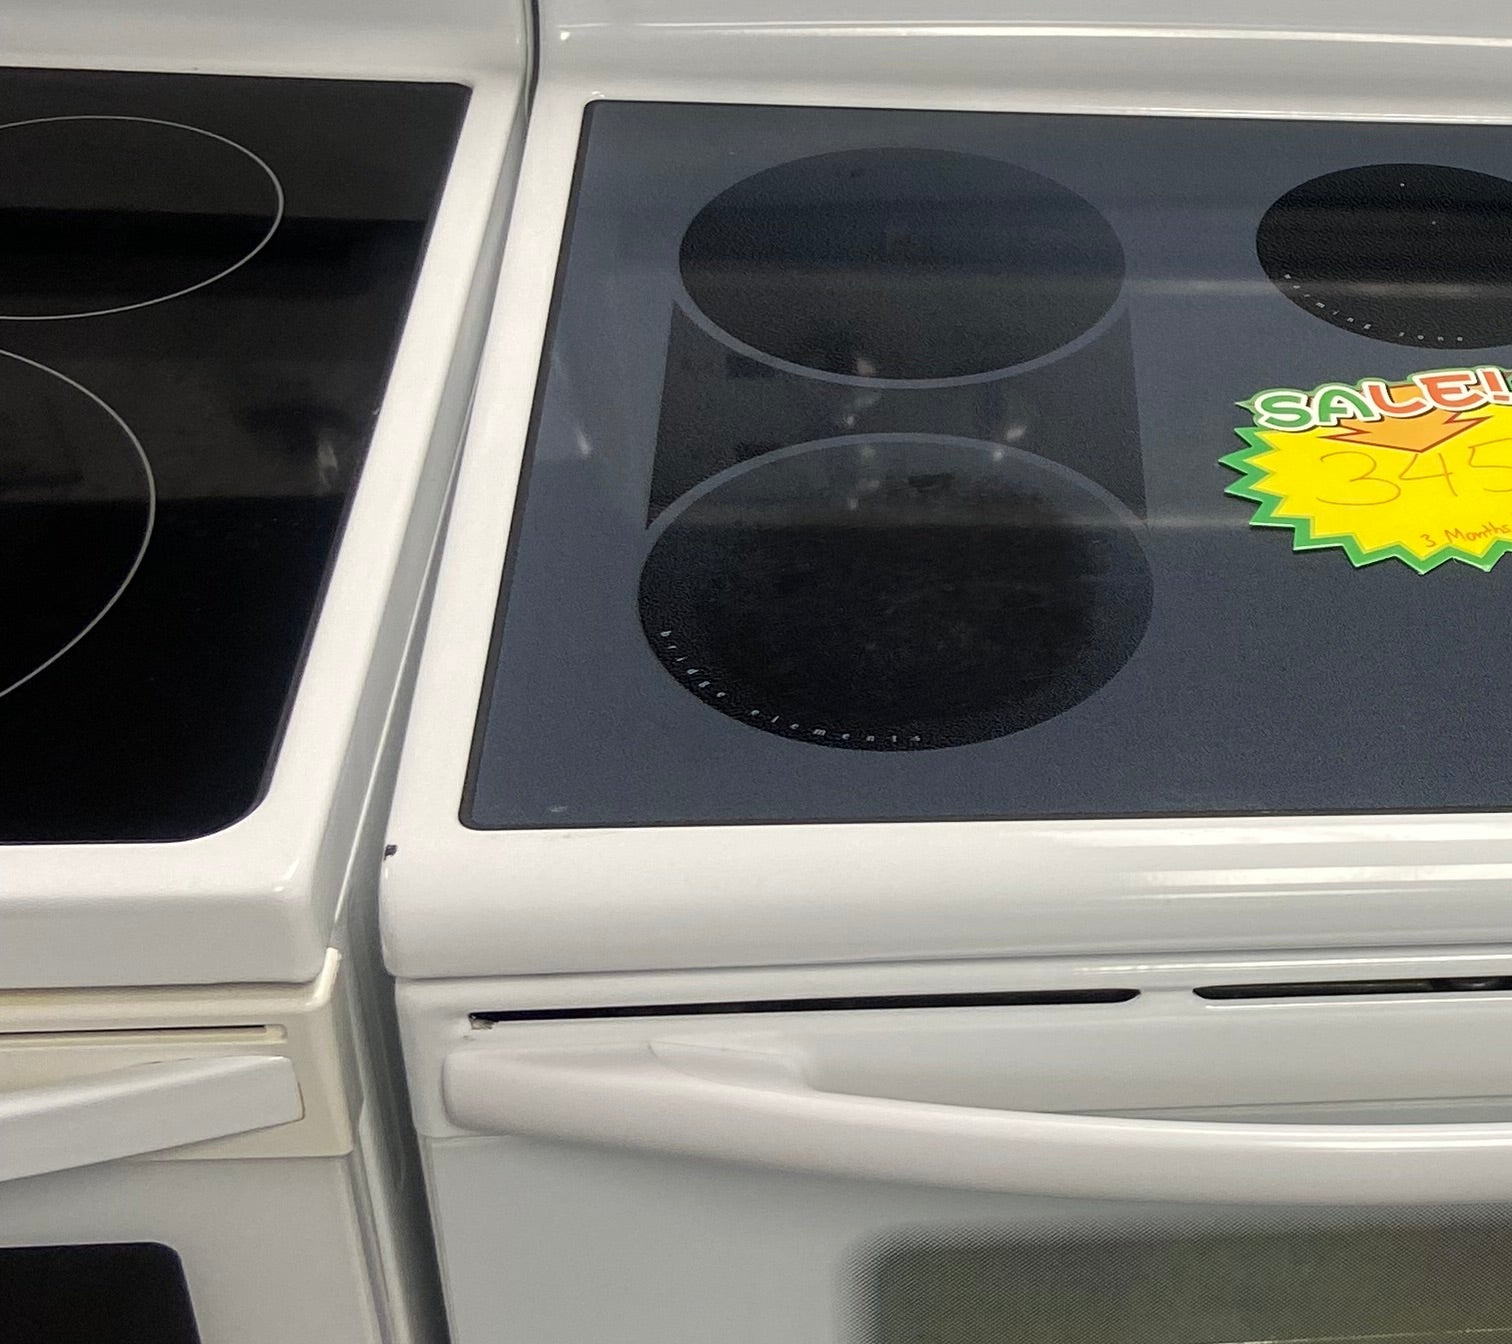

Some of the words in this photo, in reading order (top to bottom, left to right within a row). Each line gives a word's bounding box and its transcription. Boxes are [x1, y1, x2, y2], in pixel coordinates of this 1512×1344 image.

[1420, 534, 1437, 548] 3
[1445, 522, 1512, 544] Months
[660, 630, 726, 697] bridge
[751, 709, 921, 743] elements
